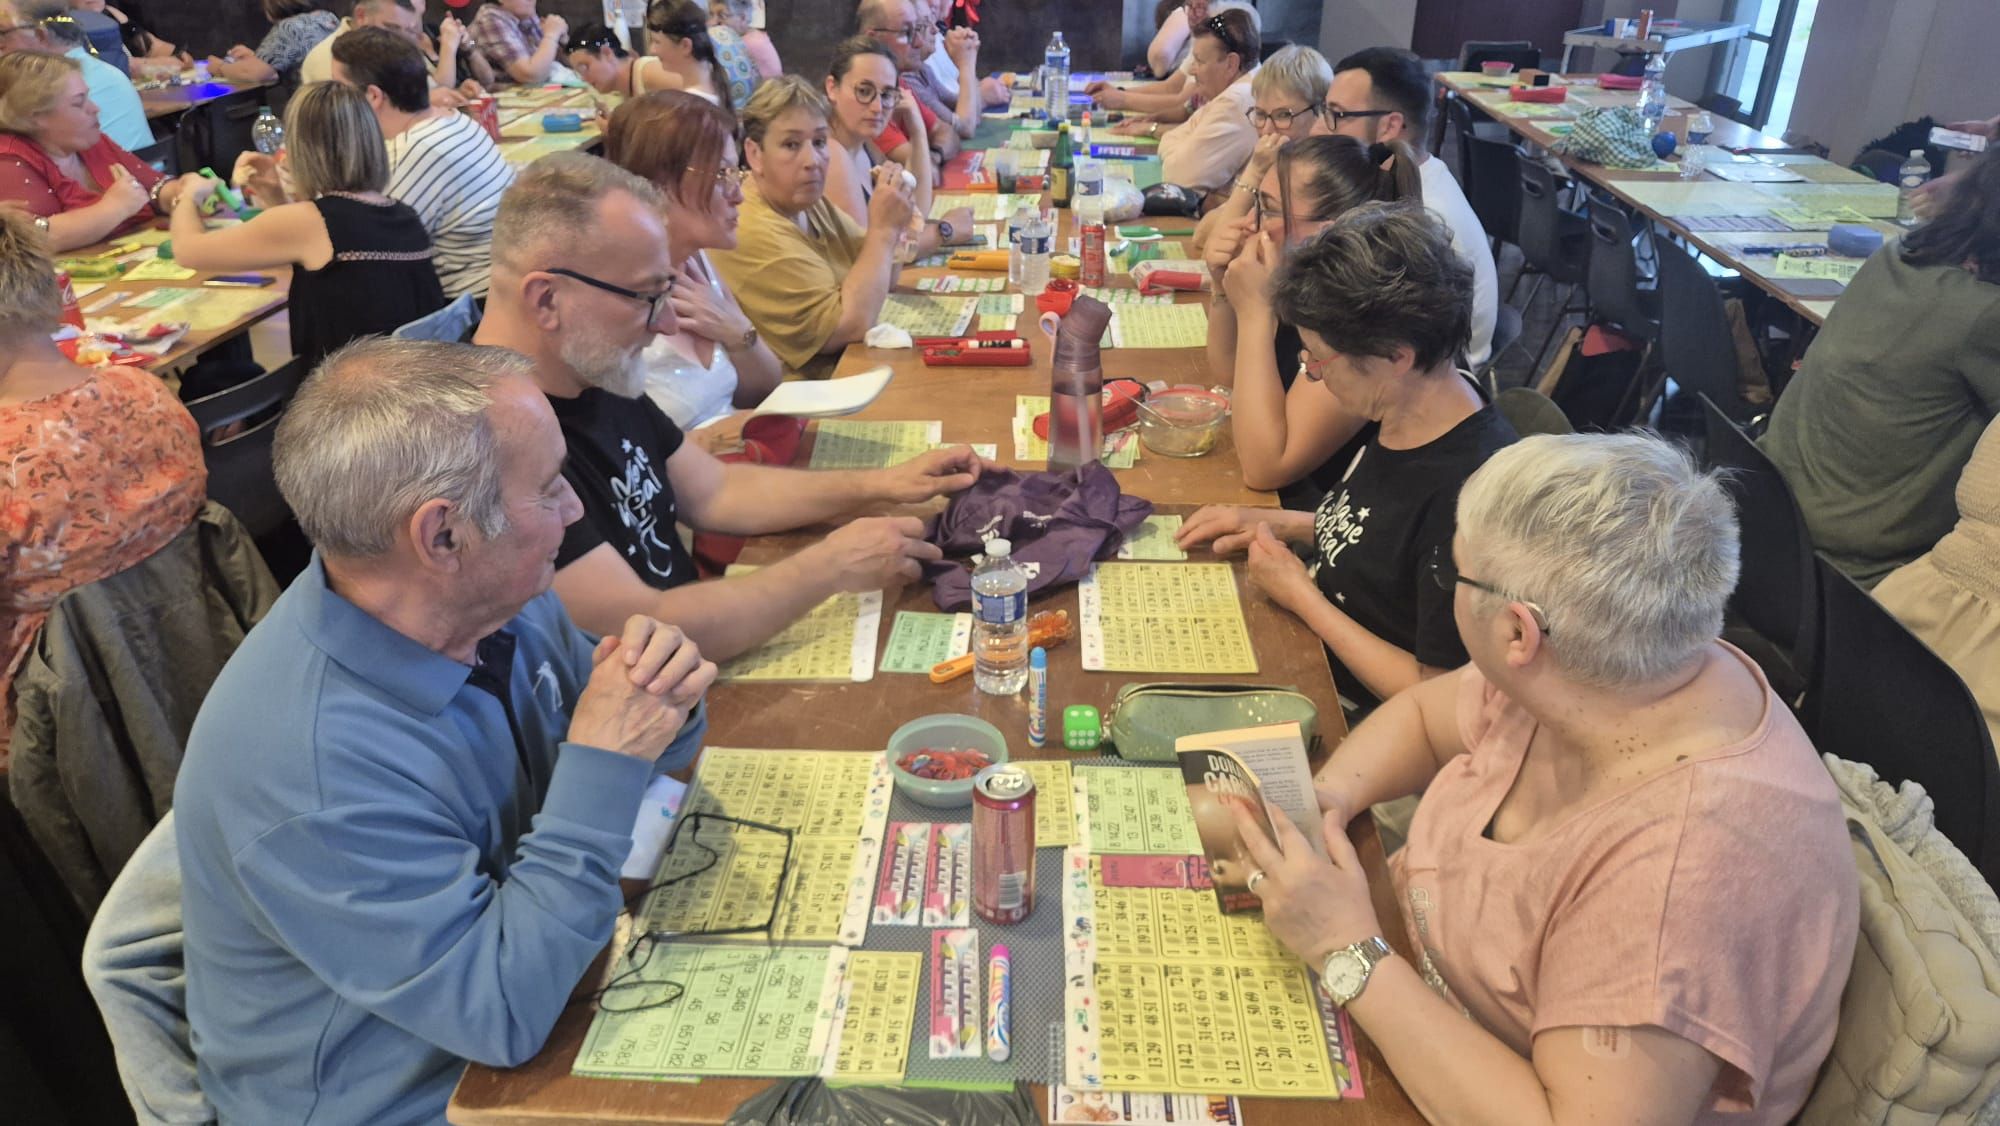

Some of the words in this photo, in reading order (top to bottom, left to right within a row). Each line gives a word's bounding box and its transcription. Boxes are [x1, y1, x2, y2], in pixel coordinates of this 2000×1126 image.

[1106, 822, 1120, 832] 22
[1126, 831, 1139, 840] 13
[1094, 889, 1109, 898] 52
[1095, 900, 1109, 910] 47
[1113, 901, 1128, 911] 46
[1181, 903, 1195, 913] 41
[1135, 911, 1149, 922] 34
[1162, 913, 1177, 923] 37
[1095, 921, 1111, 932] 23
[1135, 924, 1150, 934] 21
[1163, 924, 1178, 934] 27
[1183, 924, 1198, 936] 25
[1232, 926, 1247, 936] 24
[1116, 933, 1130, 943] 17
[1137, 934, 1152, 944] 19
[1206, 936, 1221, 946] 10
[895, 969, 911, 979] 18
[1098, 975, 1112, 985] 74
[892, 993, 907, 1004] 36
[1119, 988, 1134, 998] 64
[1192, 990, 1208, 1000] 63
[1244, 991, 1259, 1002] 69
[1287, 993, 1304, 1004] 67
[846, 1005, 861, 1015] 41
[867, 1006, 882, 1017] 44
[1143, 1002, 1158, 1012] 51
[1173, 1002, 1188, 1013] 55
[1246, 1004, 1262, 1015] 50
[1268, 1005, 1284, 1017] 59
[758, 1012, 773, 1025] 54
[778, 1012, 795, 1026] 52
[843, 1018, 859, 1029] 52
[887, 1018, 903, 1029] 51
[1121, 1014, 1136, 1025] 44
[1144, 1014, 1158, 1025] 48
[1196, 1016, 1211, 1027] 45
[1271, 1019, 1287, 1031] 49
[1294, 1020, 1310, 1032] 43
[678, 1024, 695, 1038] 65
[775, 1026, 791, 1040] 60
[1101, 1027, 1116, 1038] 36
[1199, 1031, 1214, 1042] 31
[1221, 1030, 1237, 1041] 32
[674, 1038, 691, 1051] 71
[1297, 1034, 1313, 1046] 33
[718, 1040, 736, 1053] 72
[749, 1040, 766, 1053] 74
[838, 1044, 854, 1056] 74
[1122, 1042, 1138, 1053] 28
[1146, 1042, 1161, 1054] 29
[1177, 1043, 1193, 1055] 22
[1255, 1046, 1270, 1058] 26
[1276, 1047, 1293, 1058] 20
[744, 1054, 761, 1068] 90
[1147, 1057, 1163, 1068] 13
[1179, 1059, 1194, 1069] 14
[1225, 1060, 1241, 1071] 12
[1257, 1061, 1273, 1072] 15
[1303, 1063, 1319, 1073] 16
